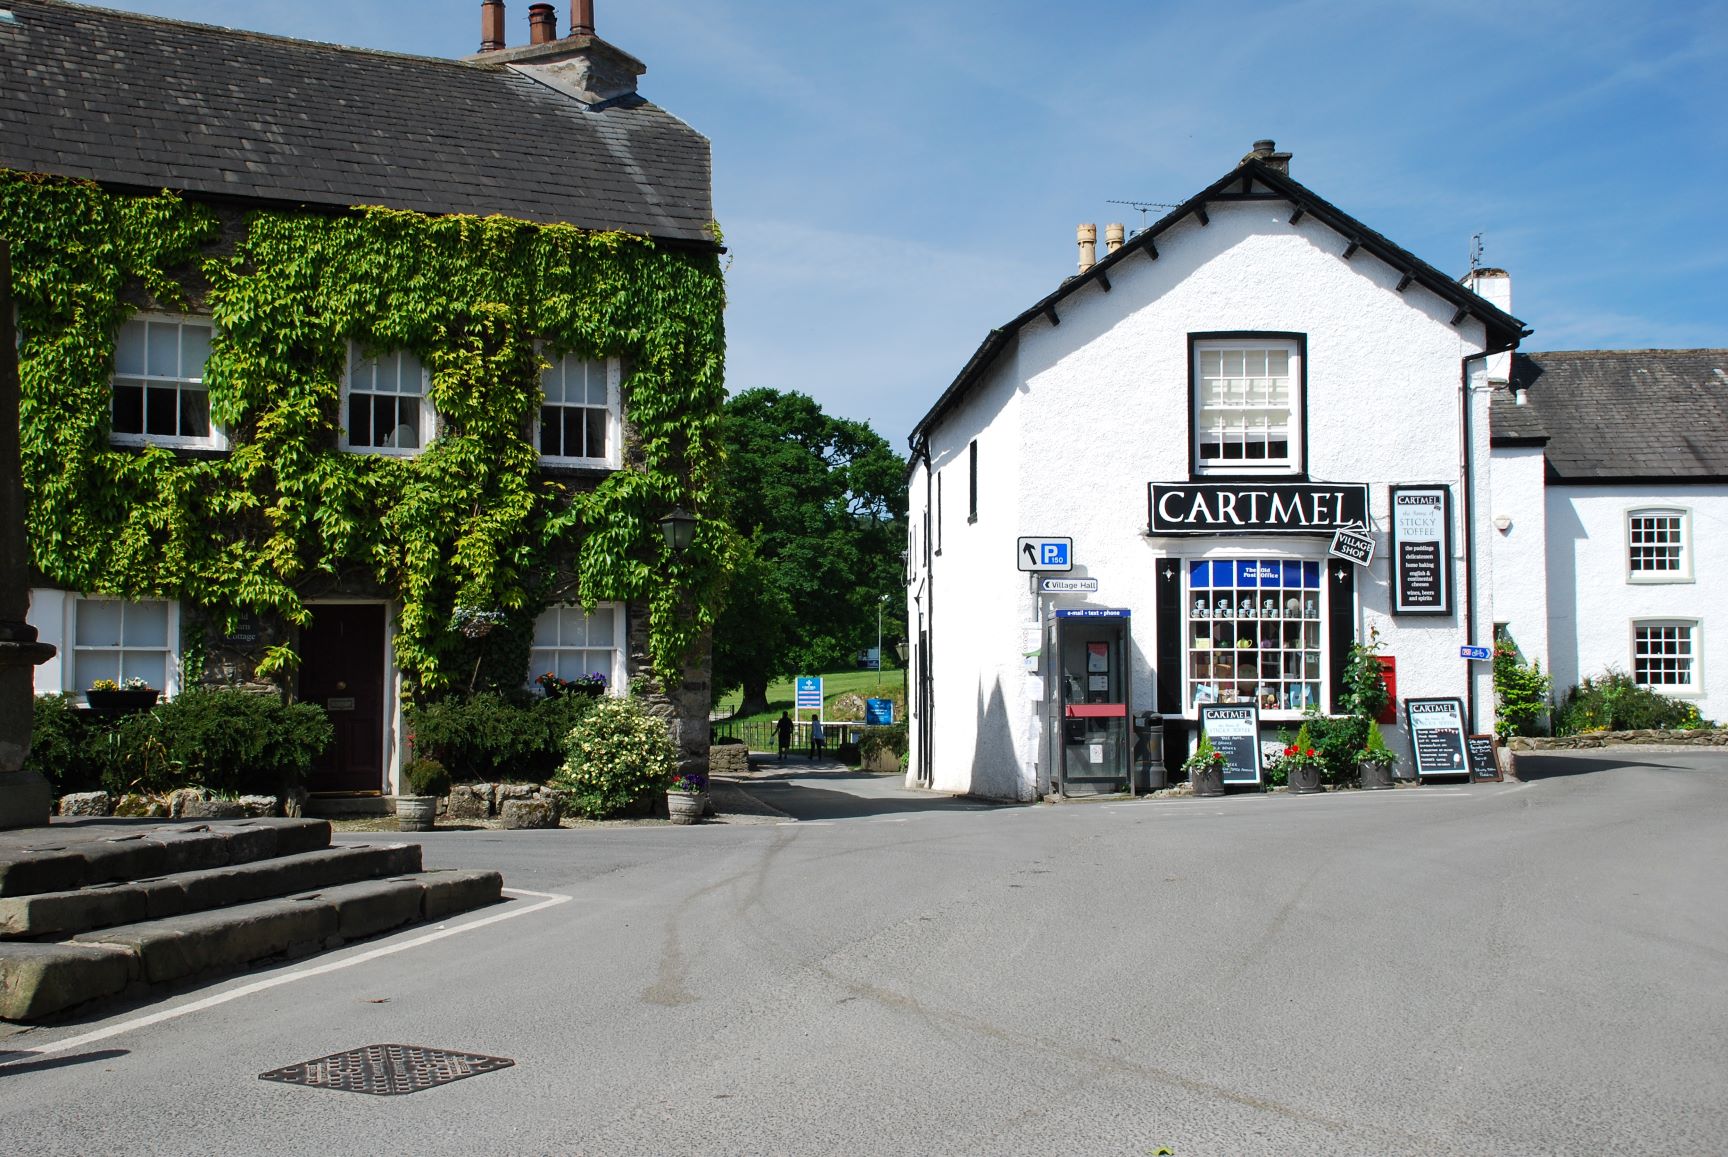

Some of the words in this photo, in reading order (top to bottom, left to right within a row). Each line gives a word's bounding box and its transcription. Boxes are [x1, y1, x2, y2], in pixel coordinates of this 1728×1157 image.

[1398, 496, 1437, 504] CARTMEL
[1158, 491, 1353, 526] CARTMEL
[1400, 518, 1436, 526] STICKY
[1402, 527, 1435, 536] TOFFEE
[1340, 534, 1372, 551] VILLAGE
[1044, 545, 1058, 564] P
[1342, 545, 1365, 558] SHOP
[1052, 581, 1078, 590] Village
[1080, 581, 1096, 589] Hall
[1413, 704, 1454, 713] CARTMEL
[1207, 710, 1249, 719] CARTMEL
